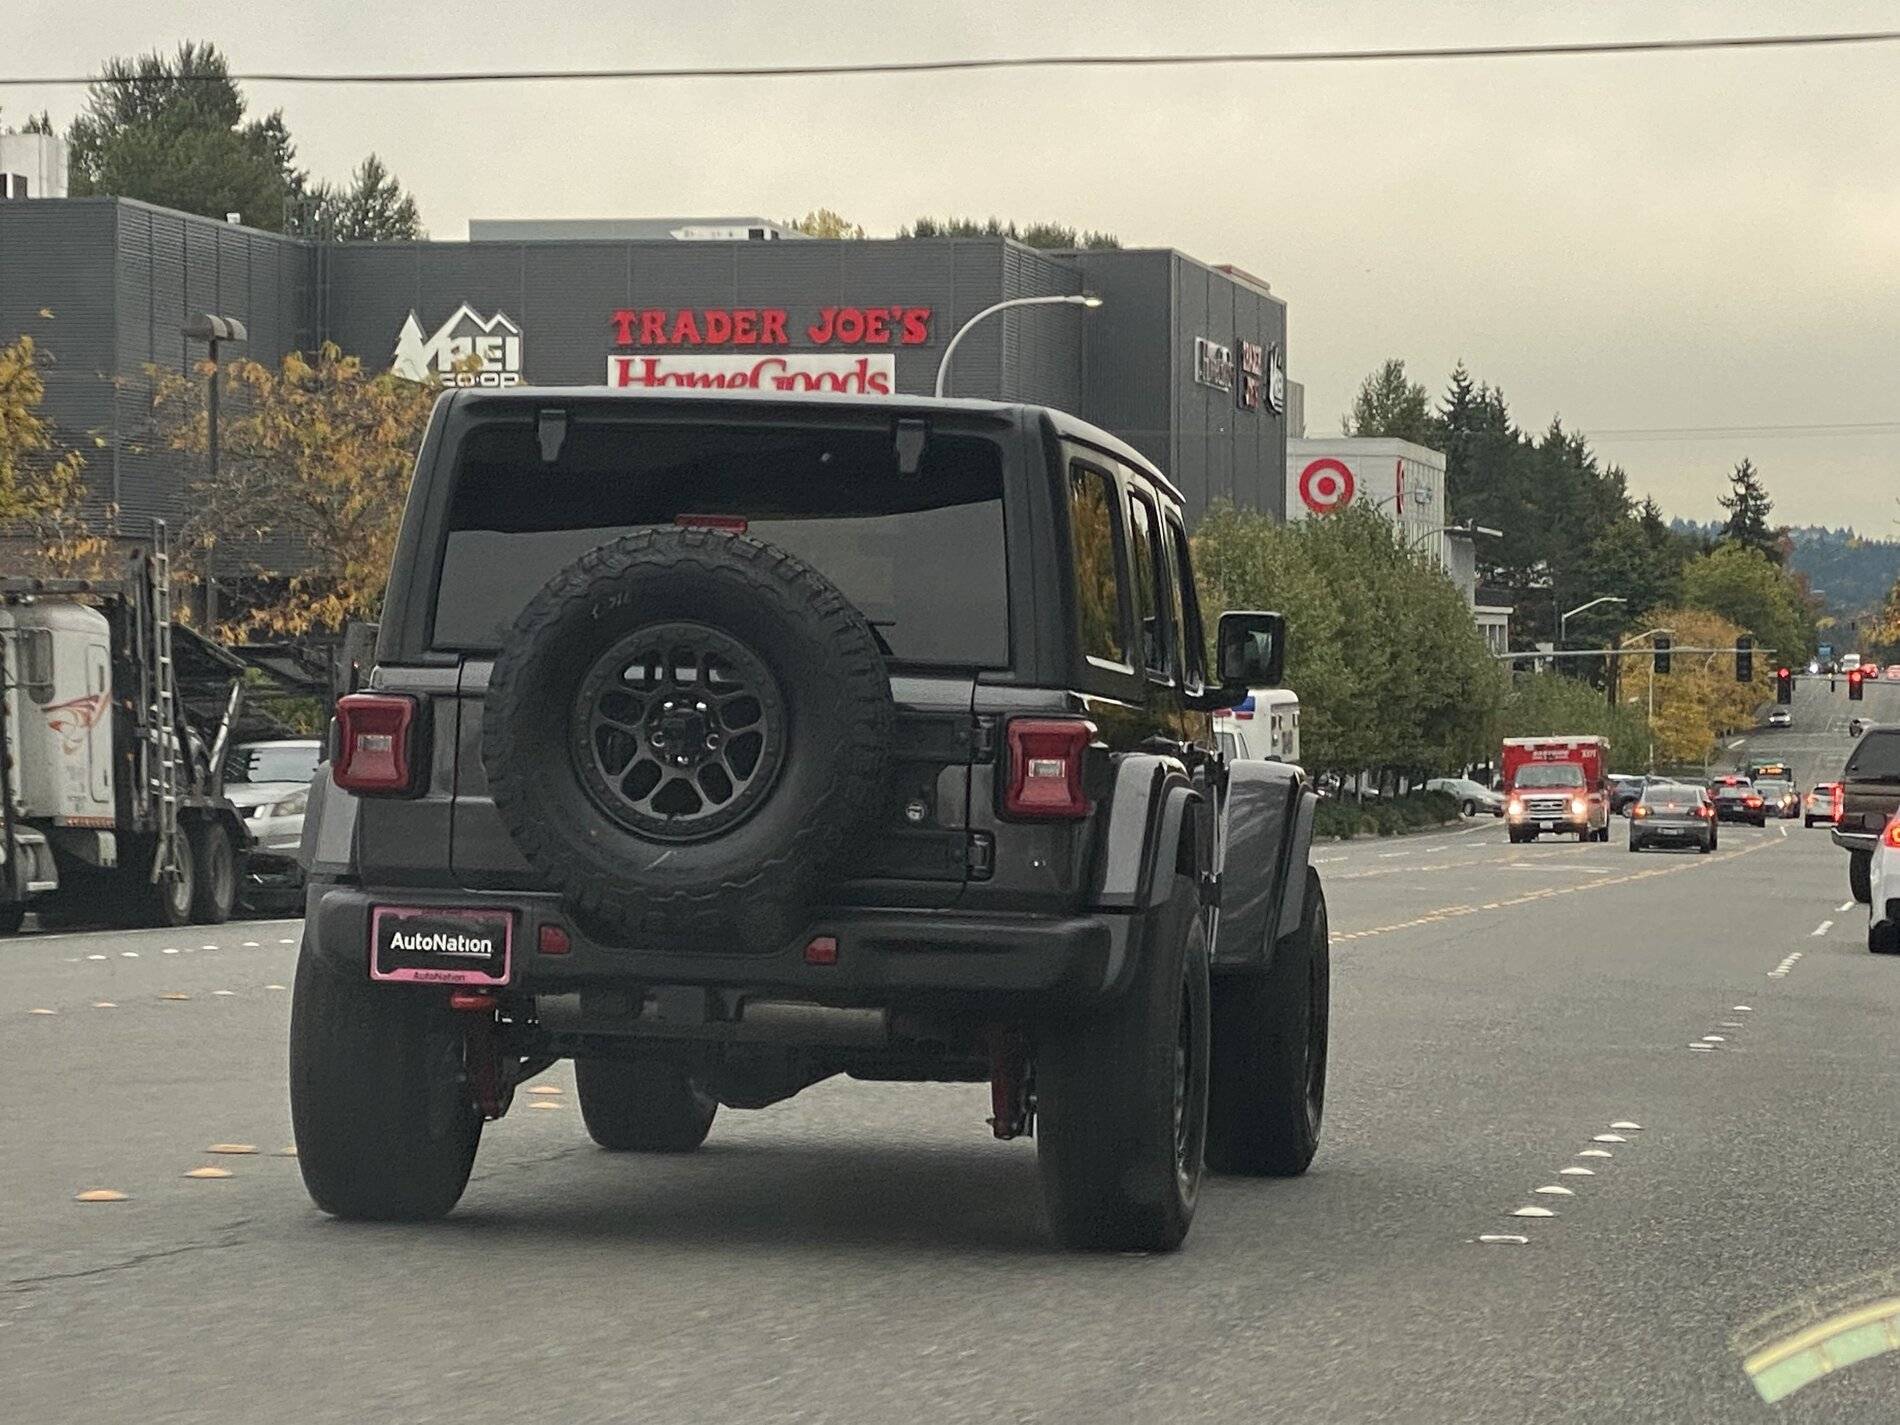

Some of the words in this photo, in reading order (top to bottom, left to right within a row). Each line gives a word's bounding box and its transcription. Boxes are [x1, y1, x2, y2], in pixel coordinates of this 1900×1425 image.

[611, 308, 789, 345] TRADER
[808, 304, 931, 345] JOE'S
[437, 336, 520, 372] REI
[614, 357, 890, 396] HomeGoods
[390, 931, 492, 953] AutoNation
[413, 971, 466, 983] AutoNation
